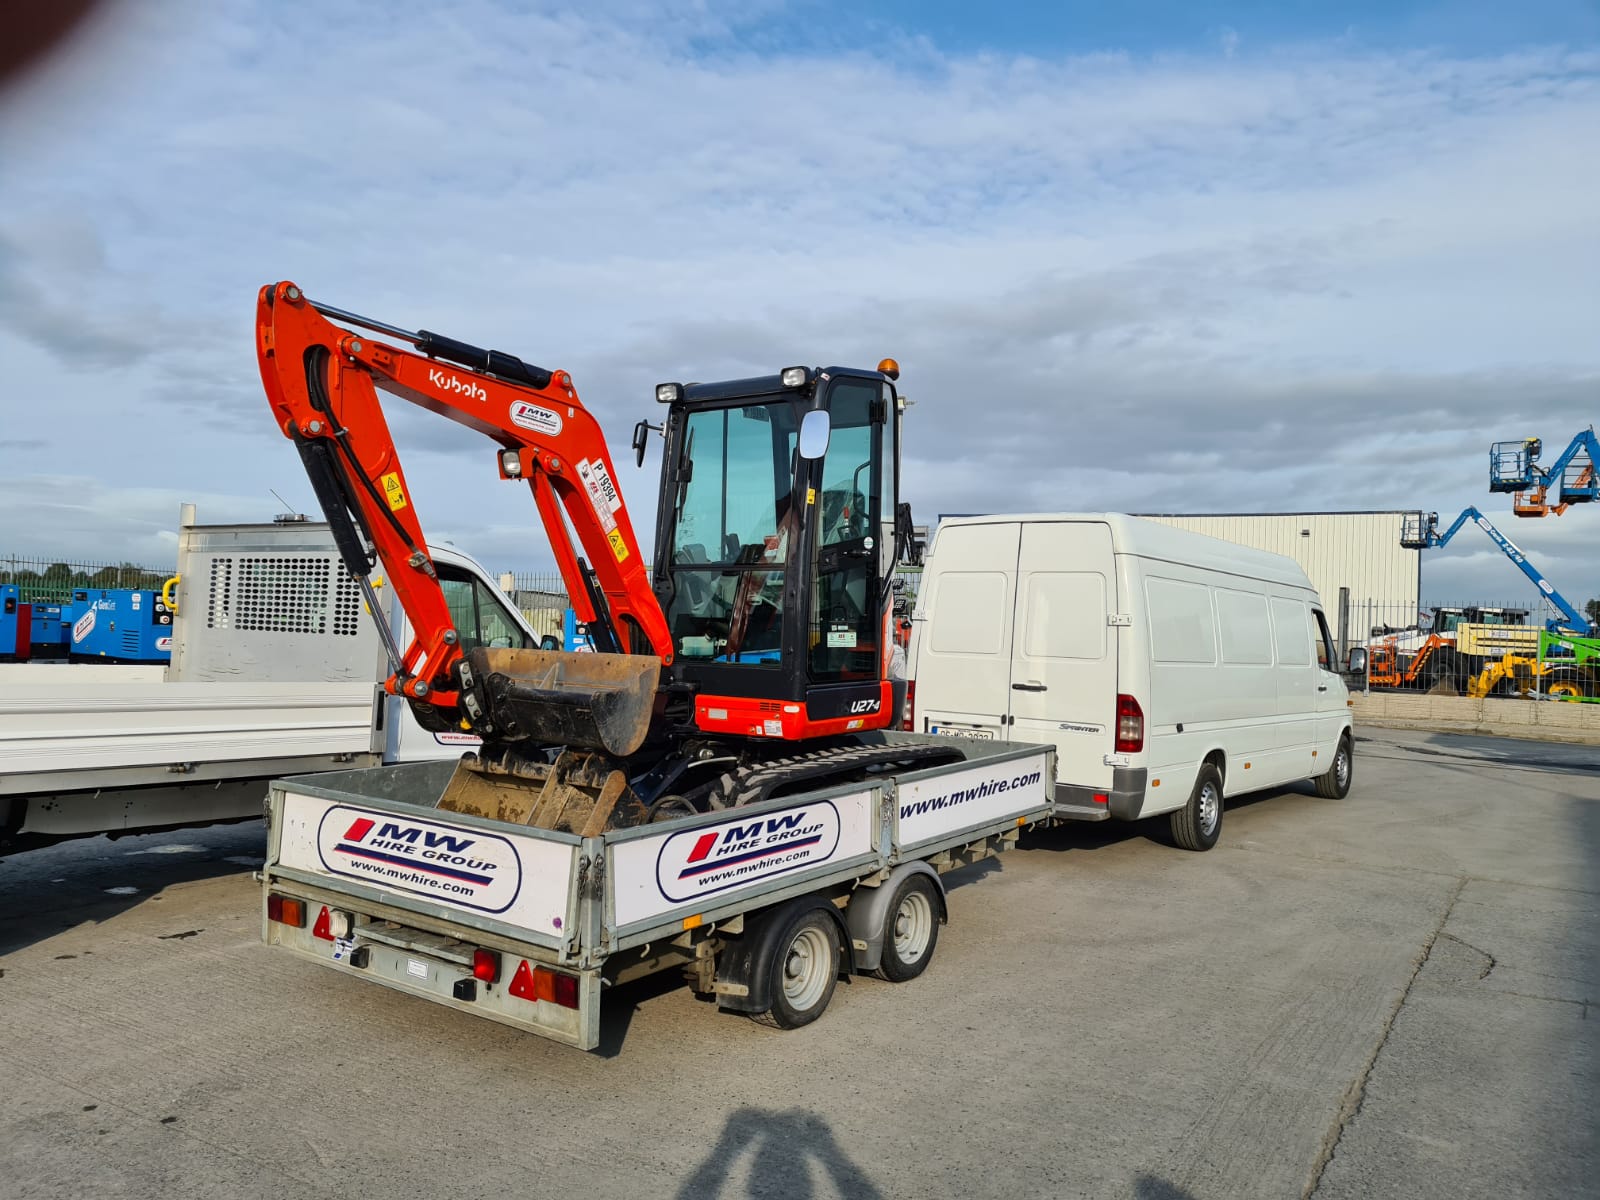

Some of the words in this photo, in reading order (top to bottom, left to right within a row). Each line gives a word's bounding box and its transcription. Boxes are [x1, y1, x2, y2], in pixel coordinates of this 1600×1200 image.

[429, 368, 487, 402] Kubota
[593, 462, 603, 471] P
[598, 473, 617, 502] 19394
[850, 699, 880, 713] U27-4
[899, 771, 1041, 819] www.mwhire.com
[377, 823, 476, 853] MW
[716, 838, 761, 857] HIRE
[766, 823, 824, 845] GROUP
[722, 812, 807, 845] MW
[369, 838, 417, 855] HIRE
[421, 850, 497, 872] GROUP
[698, 849, 810, 886] www.mwhire.com
[351, 859, 474, 897] www.mwhire.com
